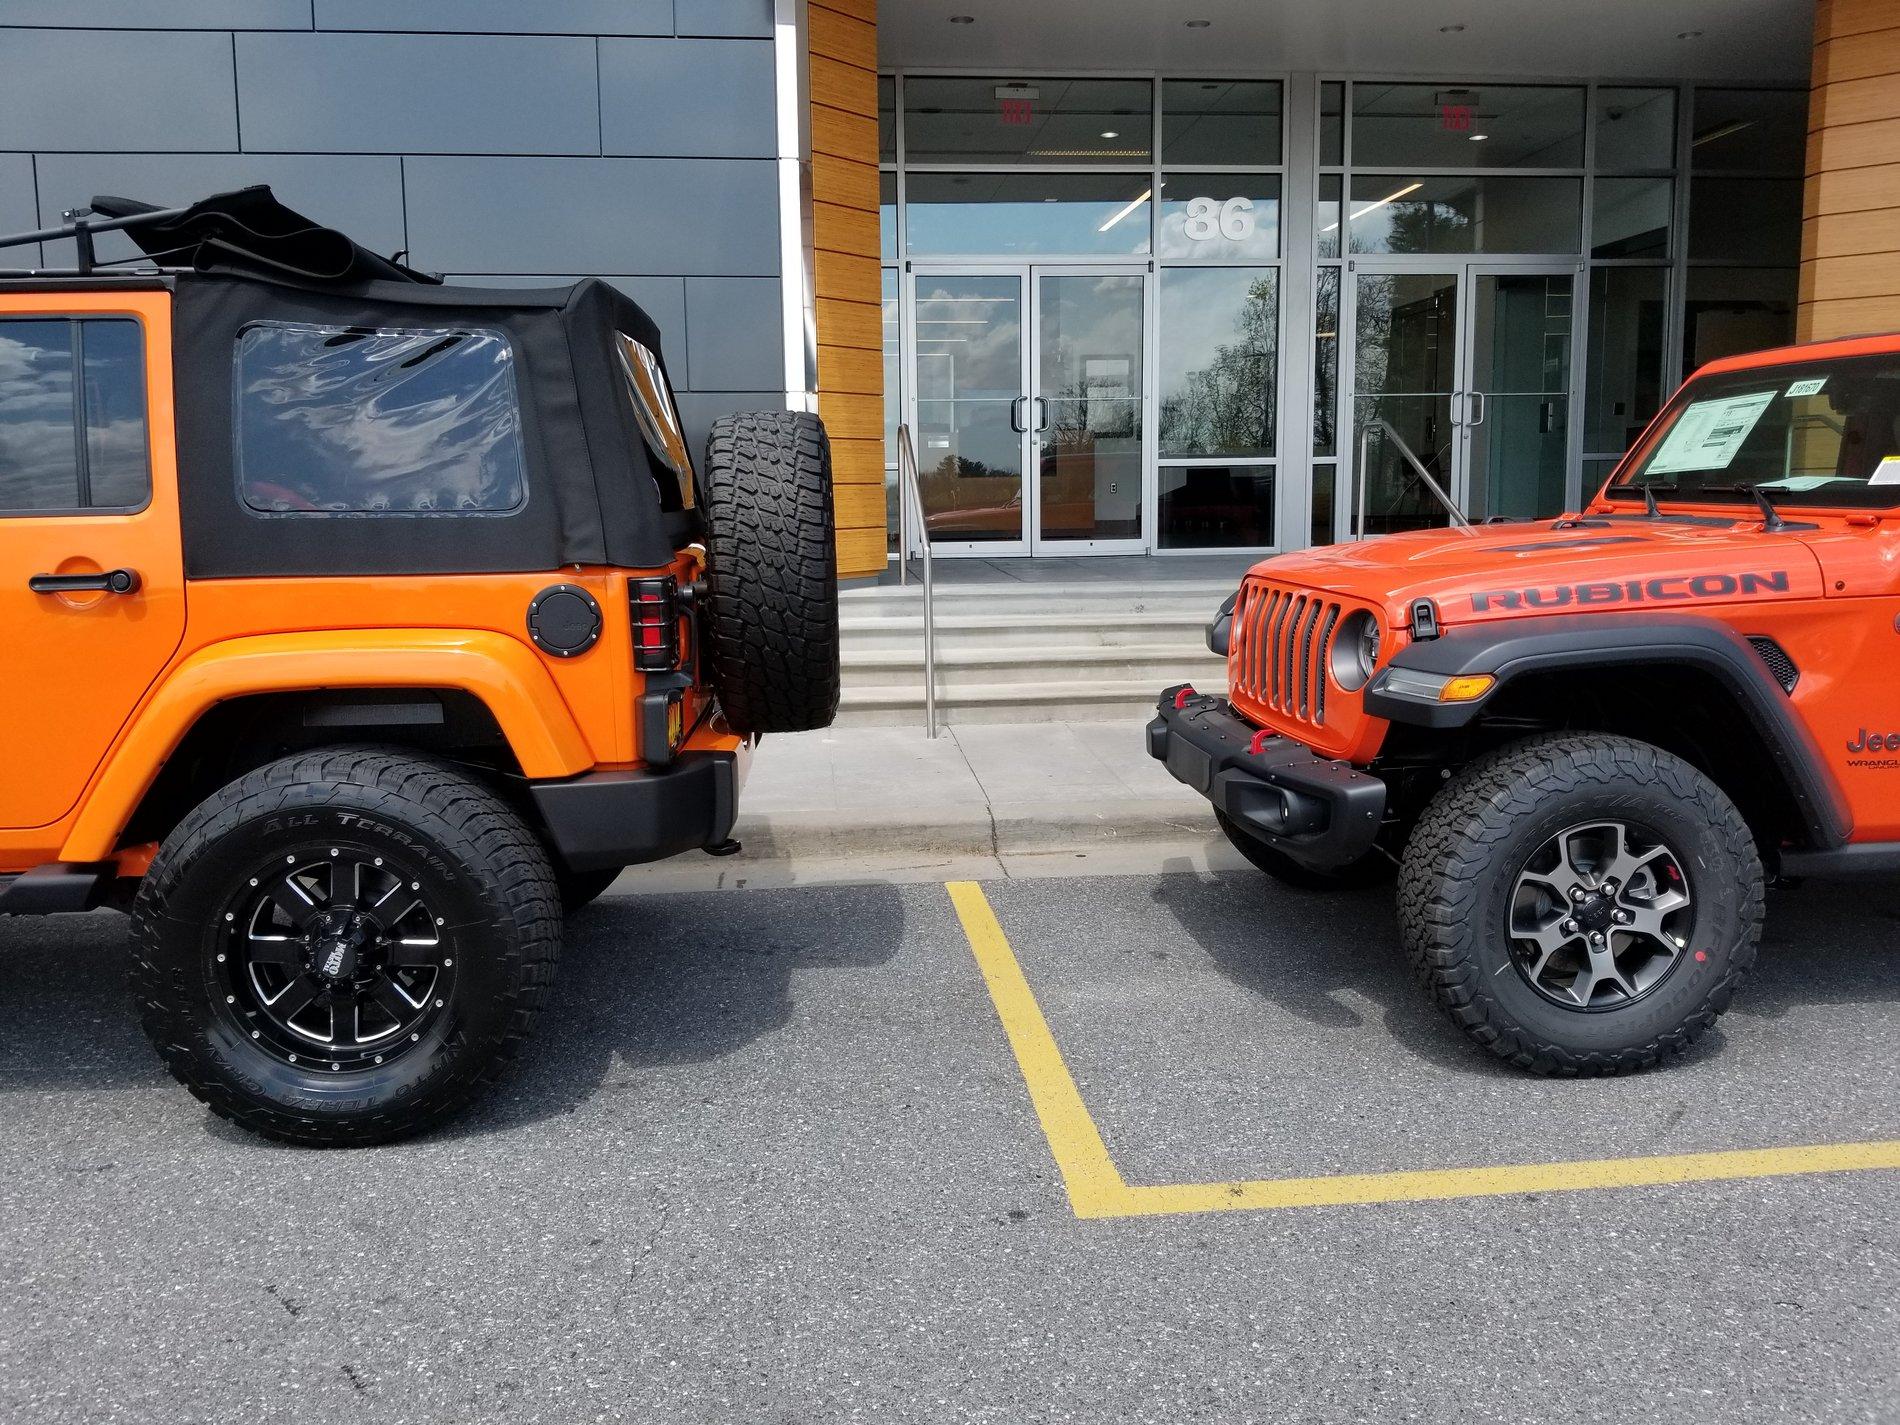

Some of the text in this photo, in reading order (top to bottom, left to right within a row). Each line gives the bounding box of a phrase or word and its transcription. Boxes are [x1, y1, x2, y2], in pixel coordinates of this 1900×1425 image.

[1184, 196, 1255, 241] 86
[1471, 570, 1789, 613] RUBICON
[329, 942, 347, 975] MOTO
